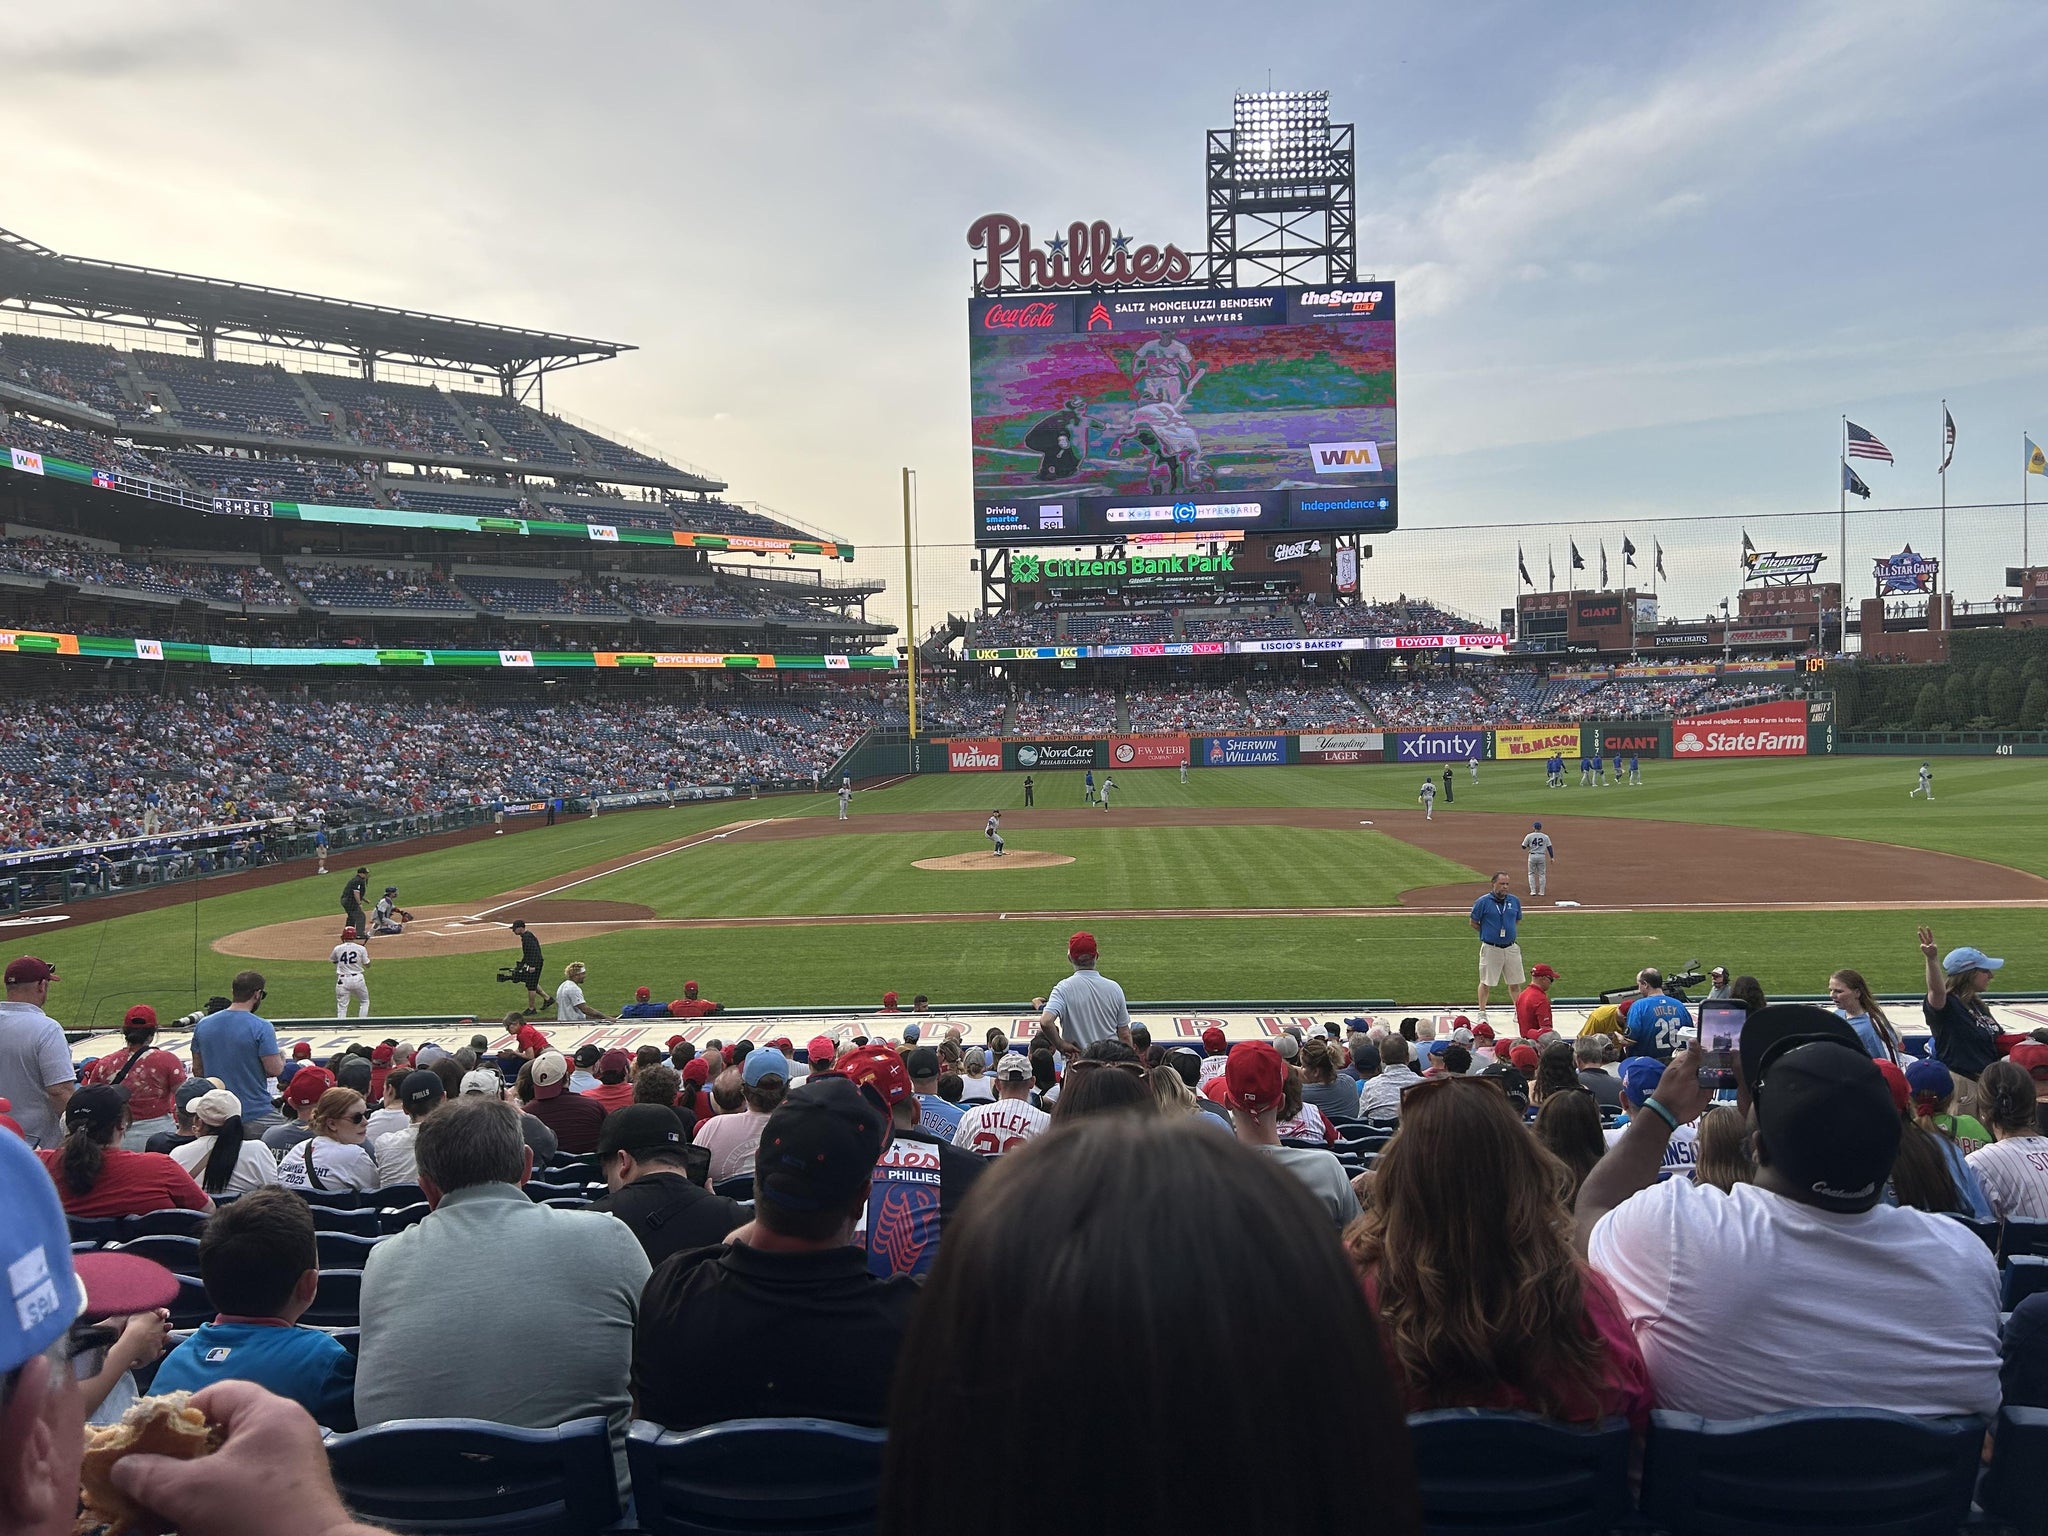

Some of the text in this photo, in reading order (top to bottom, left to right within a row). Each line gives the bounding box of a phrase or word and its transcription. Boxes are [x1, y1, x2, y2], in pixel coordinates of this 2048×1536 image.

[967, 213, 1191, 289] Phillies
[1301, 290, 1383, 305] theScore
[1115, 298, 1273, 312] SALTZ MONGELUZZI BENDESKY
[984, 302, 1058, 328] Coca-Cola
[1146, 313, 1243, 324] INJURY LAWYERS
[17, 454, 39, 468] WM
[1320, 449, 1371, 465] WM
[1301, 499, 1375, 511] Independence
[986, 507, 1016, 516] Driving
[1198, 507, 1259, 515] HYPERBARIC
[592, 528, 614, 537] WM
[986, 523, 1030, 531] outcomes.
[728, 538, 791, 549] ECYCLE RIGHT
[1043, 551, 1234, 577] Citizens Bank Park
[1754, 553, 1816, 569] Fitzpatrick
[1874, 563, 1938, 577] ALL STAR GAME
[1581, 607, 1617, 617] GIANT
[1261, 640, 1344, 650] LISCIO'S BAKERY
[1399, 637, 1440, 647] TOYOTA
[1463, 635, 1503, 645] TOYOTA
[140, 644, 160, 656] WM
[977, 647, 1078, 659] UKG UKG UKG
[1134, 645, 1161, 655] NECA
[1196, 644, 1223, 653] NECA
[505, 654, 529, 662] WM
[655, 655, 723, 664] ECYCLE RIGHT
[1805, 658, 1824, 671] 1:09
[1696, 719, 1712, 727] good
[1713, 718, 1742, 726] neighbor,
[1812, 712, 1826, 723] ANGLE
[1226, 739, 1277, 750] SHERWIN
[1315, 736, 1368, 750] Yuengling
[1402, 731, 1477, 759] xfinity
[1604, 736, 1658, 750] GIANT
[1039, 746, 1093, 758] NovaCare
[1157, 746, 1185, 754] WEBB
[1995, 745, 2013, 755] 401
[952, 751, 999, 767] Wawa
[1325, 751, 1358, 761] LAGER
[503, 803, 544, 812] heScore BET
[1531, 838, 1544, 847] 42
[340, 951, 357, 965] 42
[1653, 1006, 1678, 1016] UTLEY
[980, 1111, 1031, 1135] UTLEY
[285, 1173, 306, 1185] 2025
[888, 1170, 941, 1184] PHILLIES
